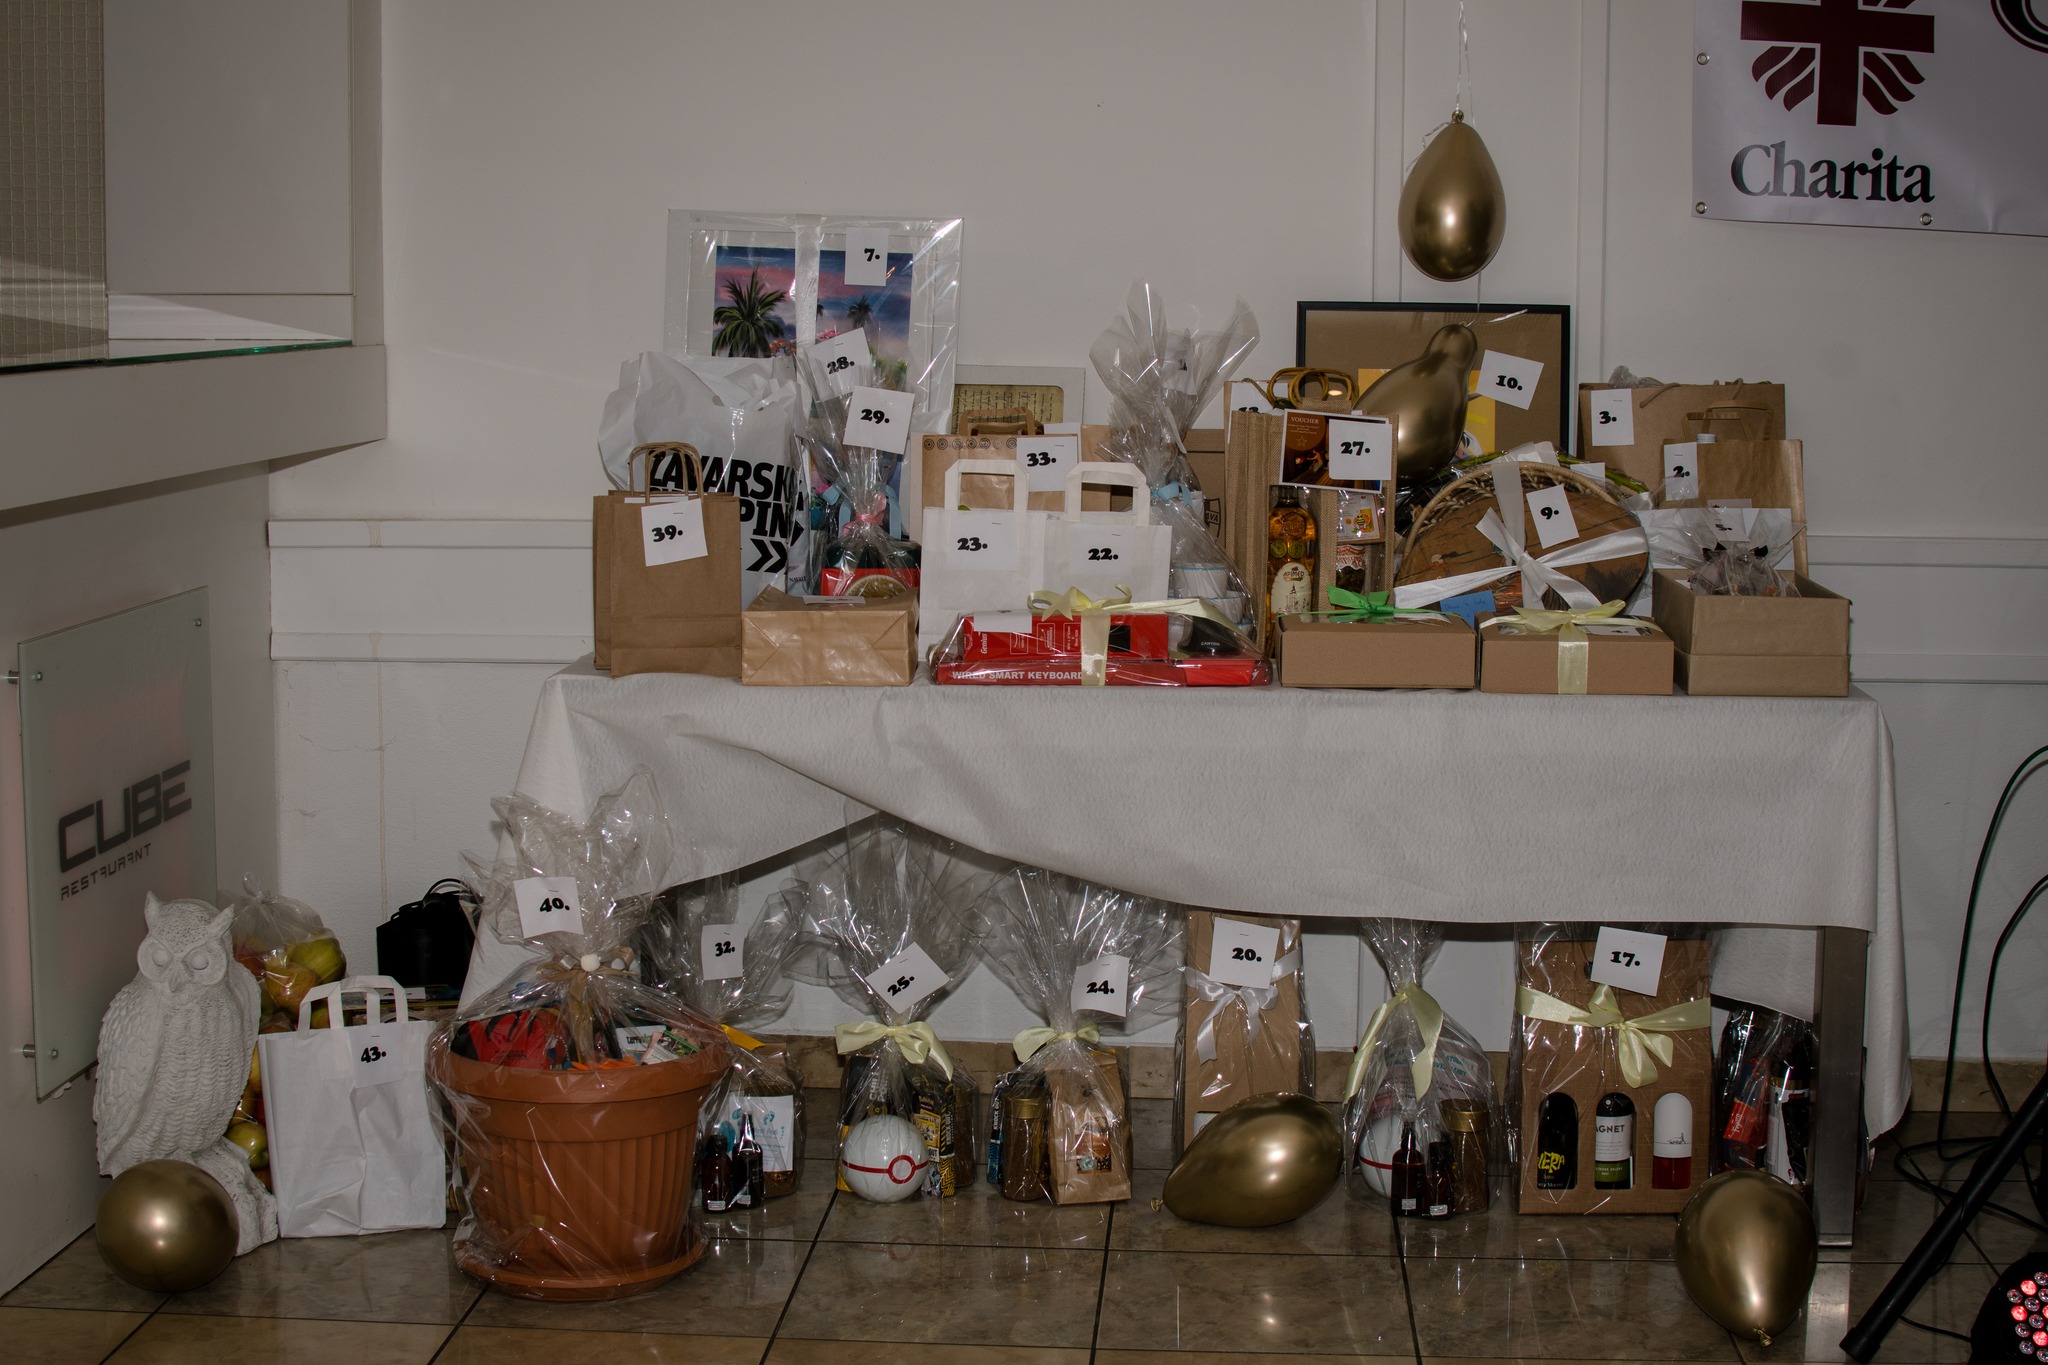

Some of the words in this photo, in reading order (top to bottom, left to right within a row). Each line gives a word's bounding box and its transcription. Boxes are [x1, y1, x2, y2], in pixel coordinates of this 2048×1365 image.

[1731, 141, 1935, 204] Charita
[863, 247, 881, 262] 7.
[826, 356, 856, 375] 28.
[1495, 374, 1523, 391] 10.
[860, 408, 890, 425] 29.
[1290, 416, 1320, 425] VOUCHER
[1598, 410, 1618, 425] 3.
[1340, 440, 1371, 457] 27.
[1026, 451, 1057, 468] 33.
[1672, 465, 1691, 479] 2.
[1540, 506, 1560, 520] 9.
[651, 524, 684, 543] 39.
[956, 536, 988, 552] 23.
[1087, 547, 1119, 561] 22.
[980, 633, 988, 655] Genius
[952, 671, 986, 680] WIRED
[989, 671, 1025, 679] SMART
[58, 760, 192, 873] CUBE
[539, 897, 571, 913] 40.
[714, 940, 736, 958] 32.
[1231, 947, 1263, 963] 20.
[1609, 950, 1641, 968] 17.
[887, 975, 915, 997] 25.
[1086, 979, 1115, 995] 24.
[360, 1045, 387, 1064] 43.
